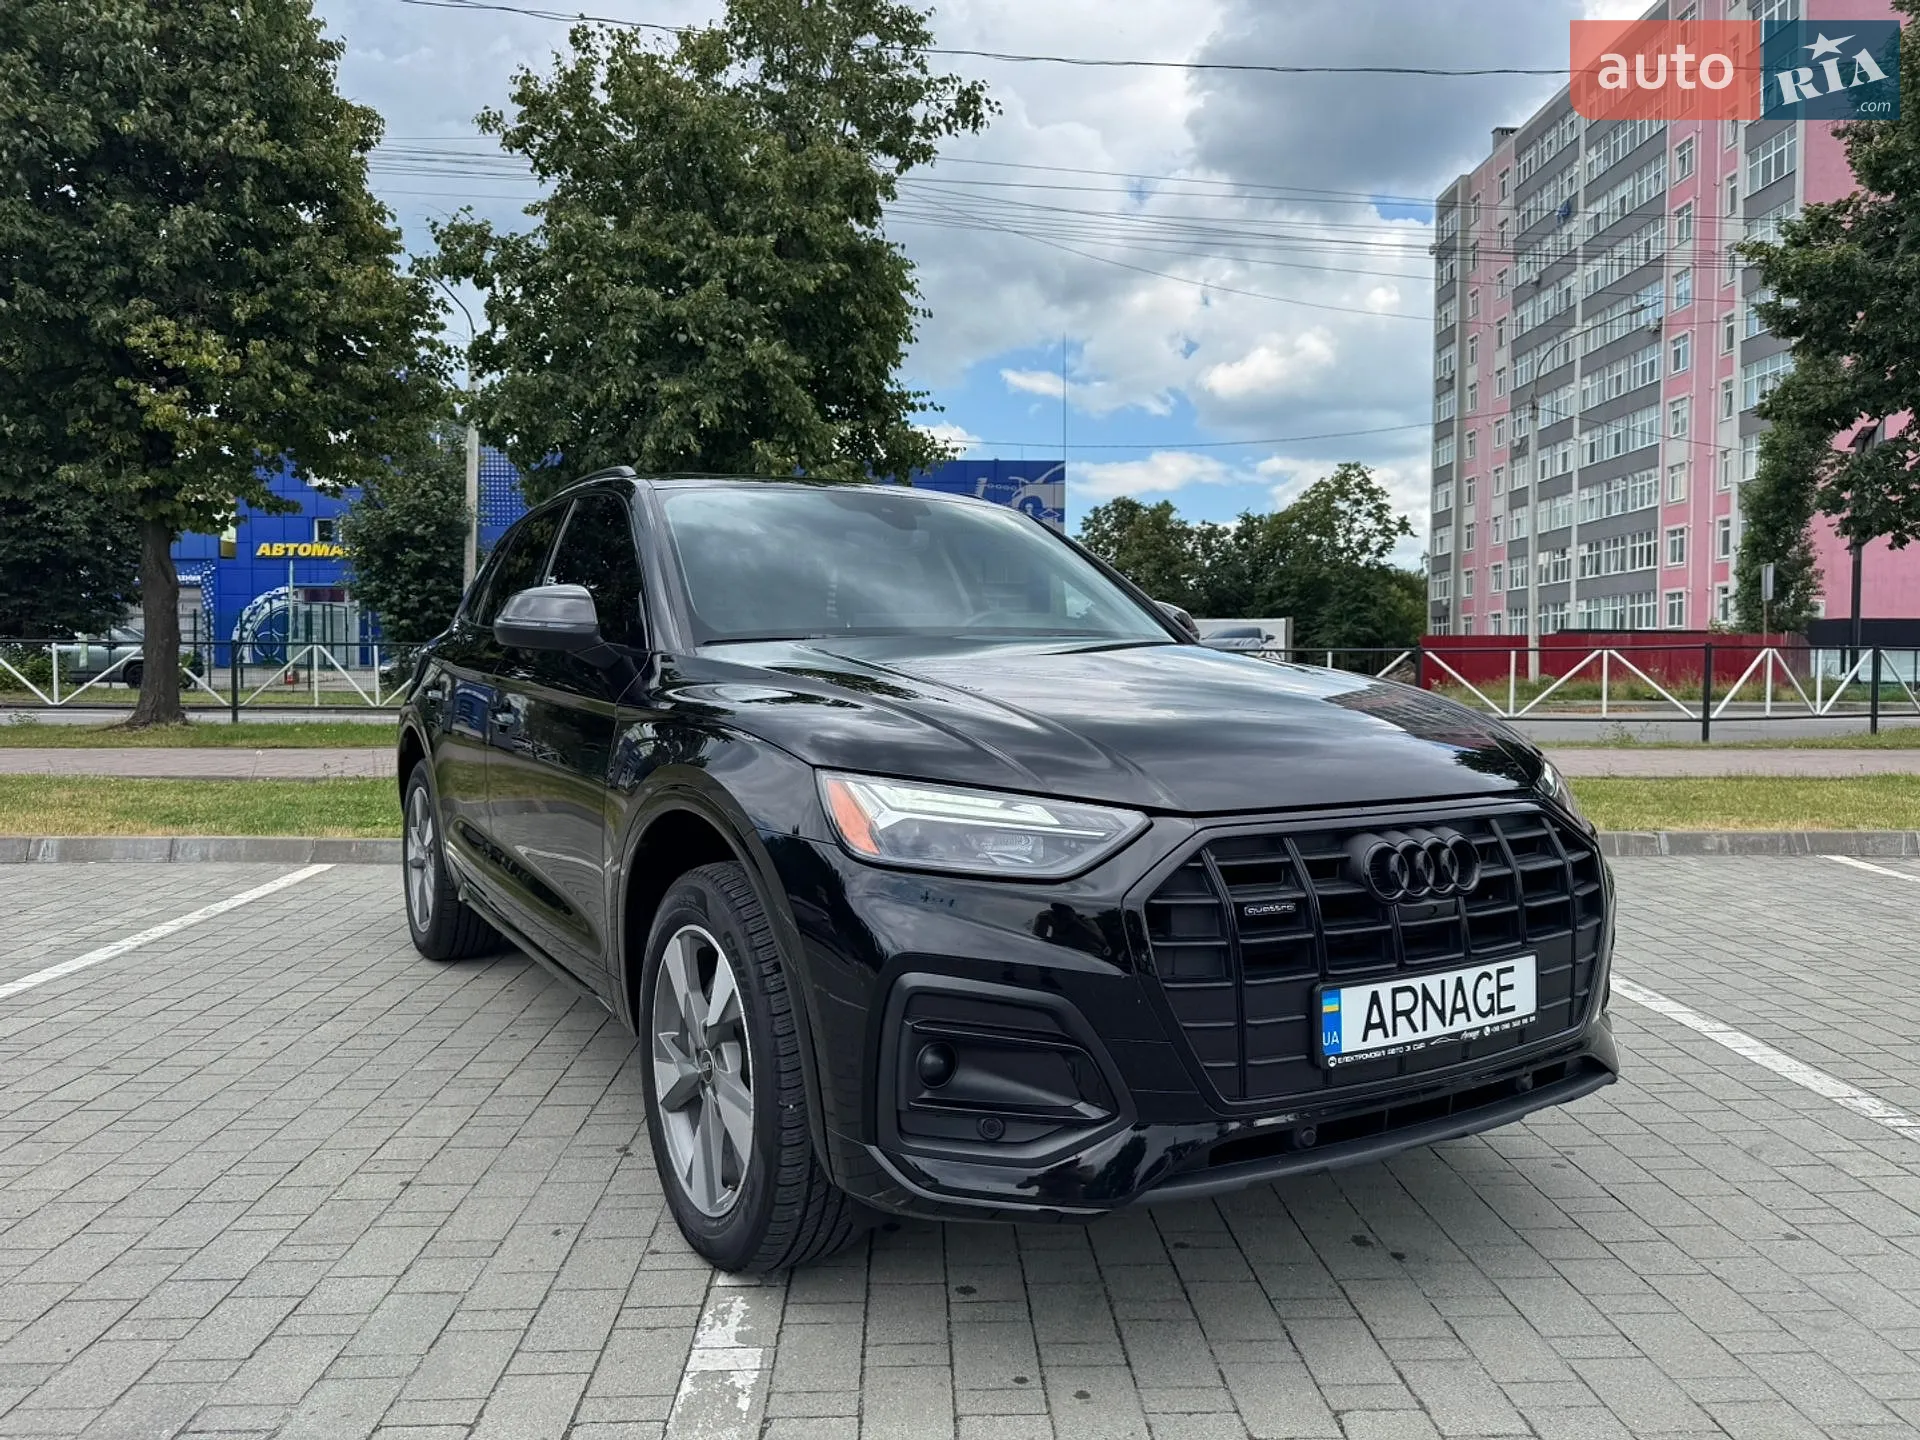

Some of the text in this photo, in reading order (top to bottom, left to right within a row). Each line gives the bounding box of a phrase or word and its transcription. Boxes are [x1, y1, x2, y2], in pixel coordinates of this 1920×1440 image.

[256, 543, 350, 557] АВТОМА
[1361, 965, 1516, 1043] ARNAGE
[1322, 1031, 1340, 1046] UA
